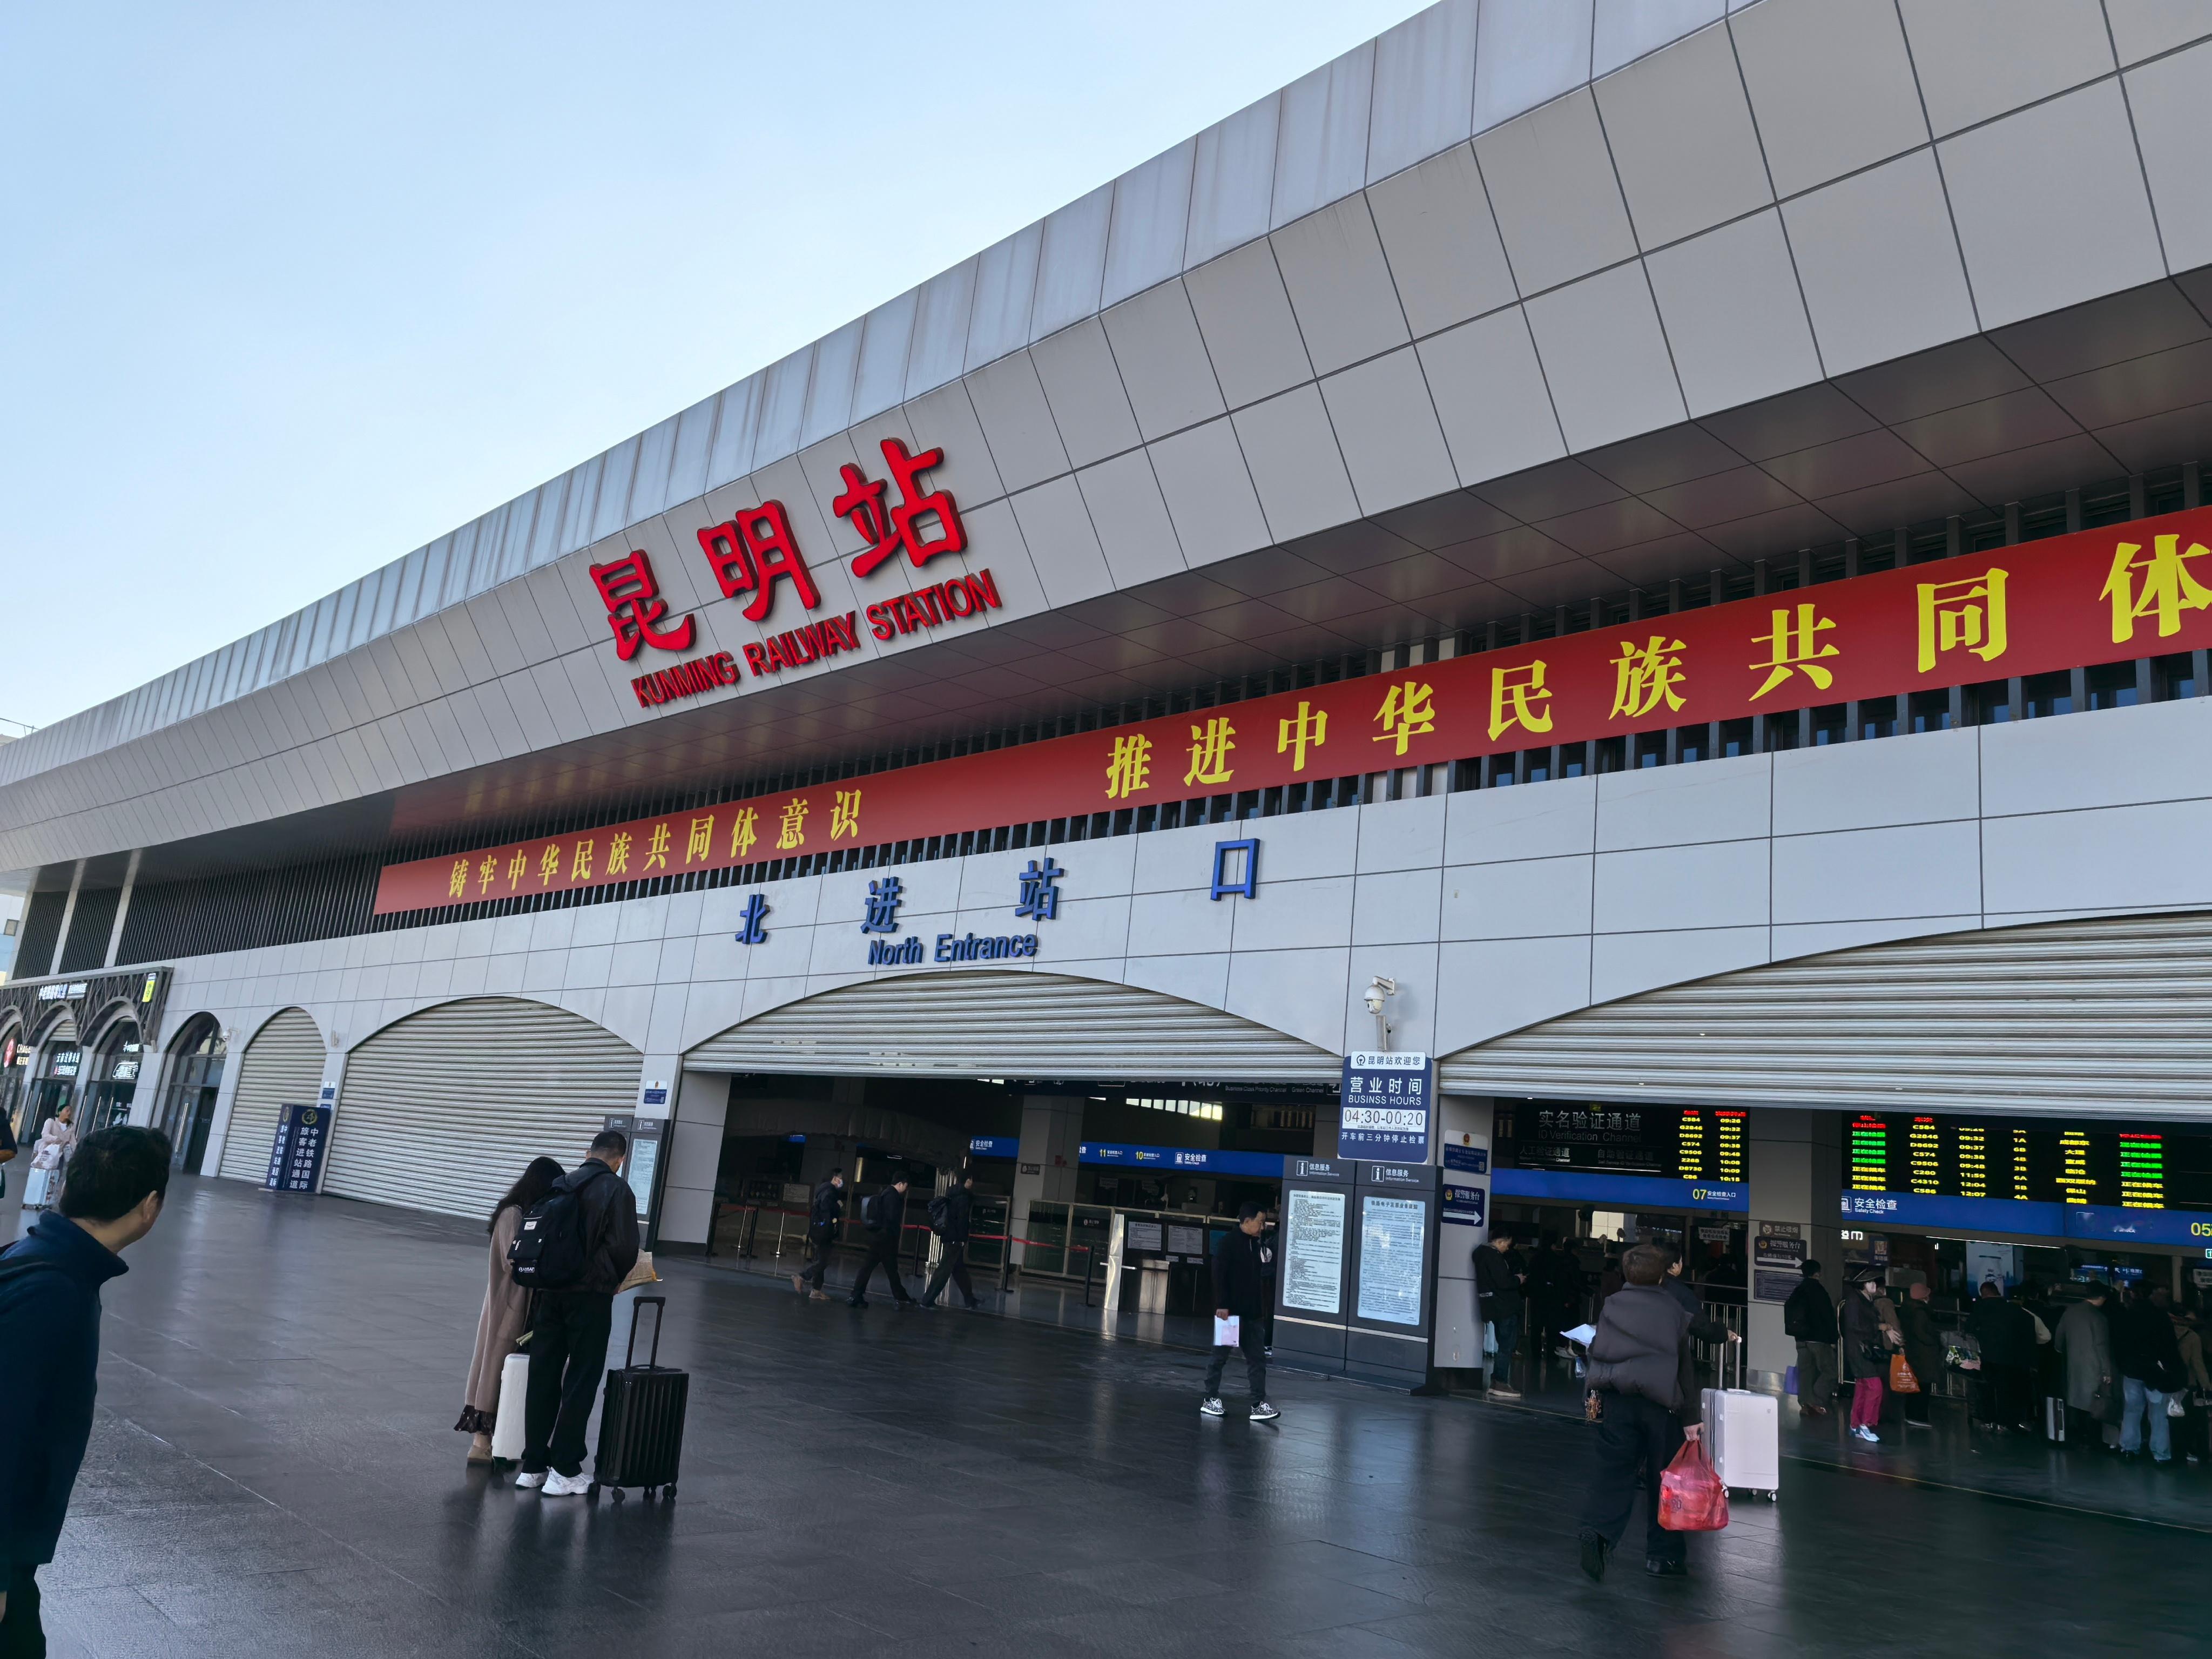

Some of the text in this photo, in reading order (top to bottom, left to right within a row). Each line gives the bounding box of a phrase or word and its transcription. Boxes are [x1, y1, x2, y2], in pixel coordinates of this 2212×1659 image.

[589, 437, 968, 661] 昆明站
[630, 568, 1003, 707] KUNMING RAILWAY STATION
[448, 535, 2212, 899] 铸牢中华民族共同体意识 推进中华民族共同体
[868, 933, 1038, 965] North Entrance
[1368, 1056, 1420, 1065] 昆明站欢迎您
[1351, 1076, 1422, 1095] 营业时间
[1348, 1095, 1421, 1105] BUSINSS HOURS
[1345, 1109, 1423, 1125] 04:30-00:20
[1539, 1110, 1641, 1131] 实名验证通道
[1342, 1132, 1425, 1144] 开车前三分钟停止检票
[1539, 1131, 1641, 1143] ID Verification Channel
[289, 1127, 309, 1189] 旅客进站通道
[299, 1128, 319, 1189] 中老铁路国际
[1100, 1149, 1106, 1157] 11
[1135, 1151, 1143, 1159] 10
[1184, 1154, 1206, 1162] 安全检查
[1309, 1163, 1330, 1171] 信息服务
[1386, 1169, 1408, 1177] 信息服务
[1455, 1189, 1480, 1201] 报警服务台
[1692, 1189, 1707, 1200] 07
[1854, 1197, 1897, 1210] 安全检查
[2191, 1223, 2211, 1237] 05
